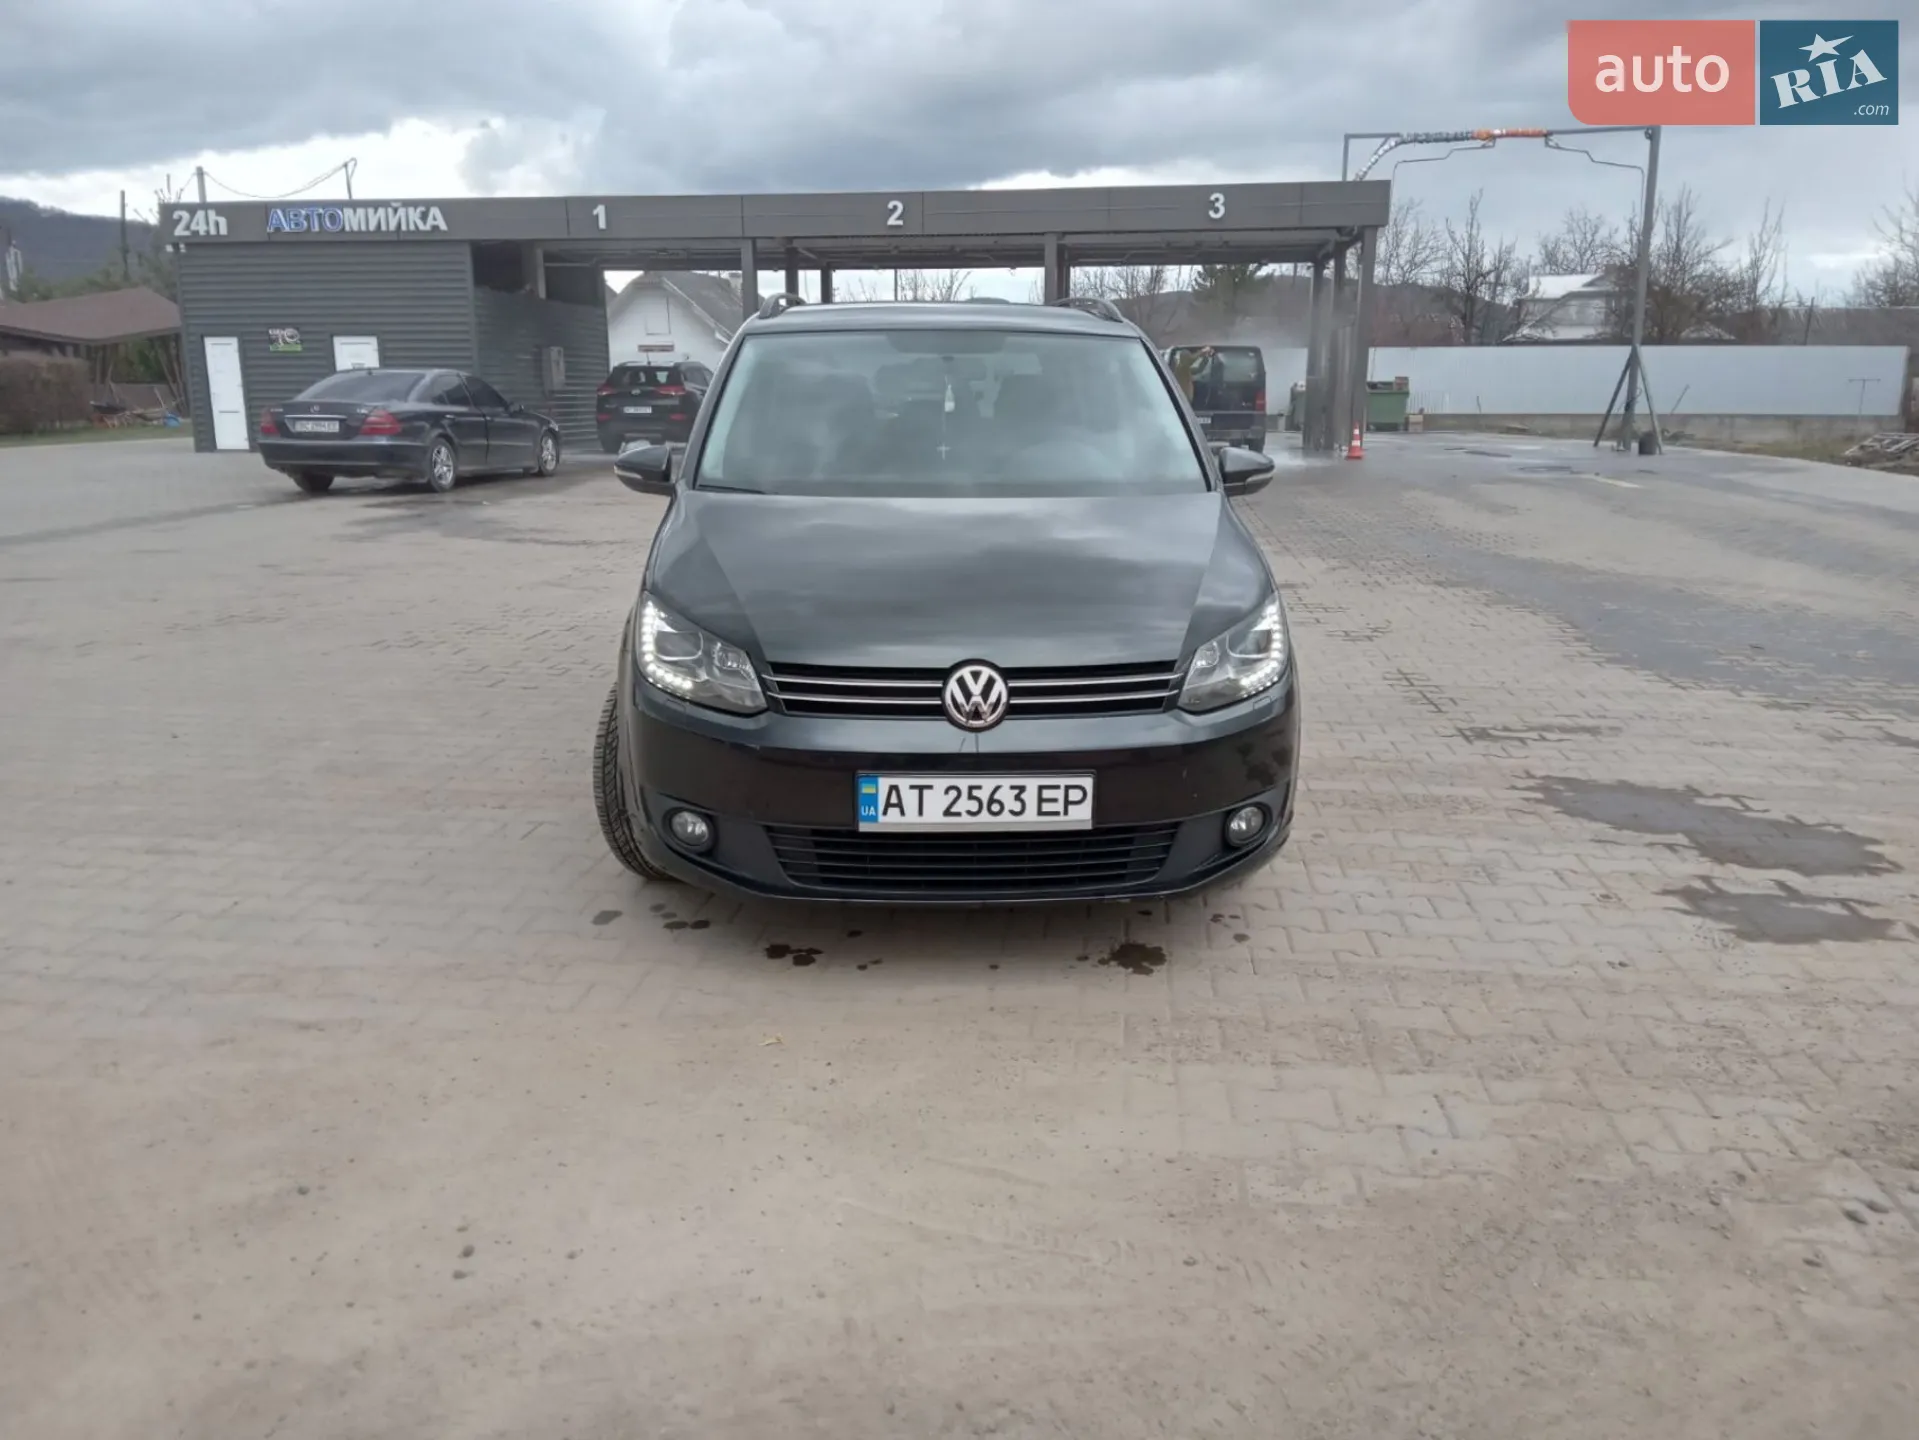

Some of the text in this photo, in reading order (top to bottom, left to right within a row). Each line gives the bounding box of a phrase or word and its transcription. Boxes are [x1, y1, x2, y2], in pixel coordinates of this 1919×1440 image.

[266, 202, 449, 233] АВТОМИЙКА
[592, 204, 607, 230] 1
[887, 200, 904, 226] 2
[1208, 192, 1226, 219] 3
[172, 209, 229, 236] 24h
[861, 805, 877, 817] UA
[882, 784, 1088, 817] AT 2563 EP
